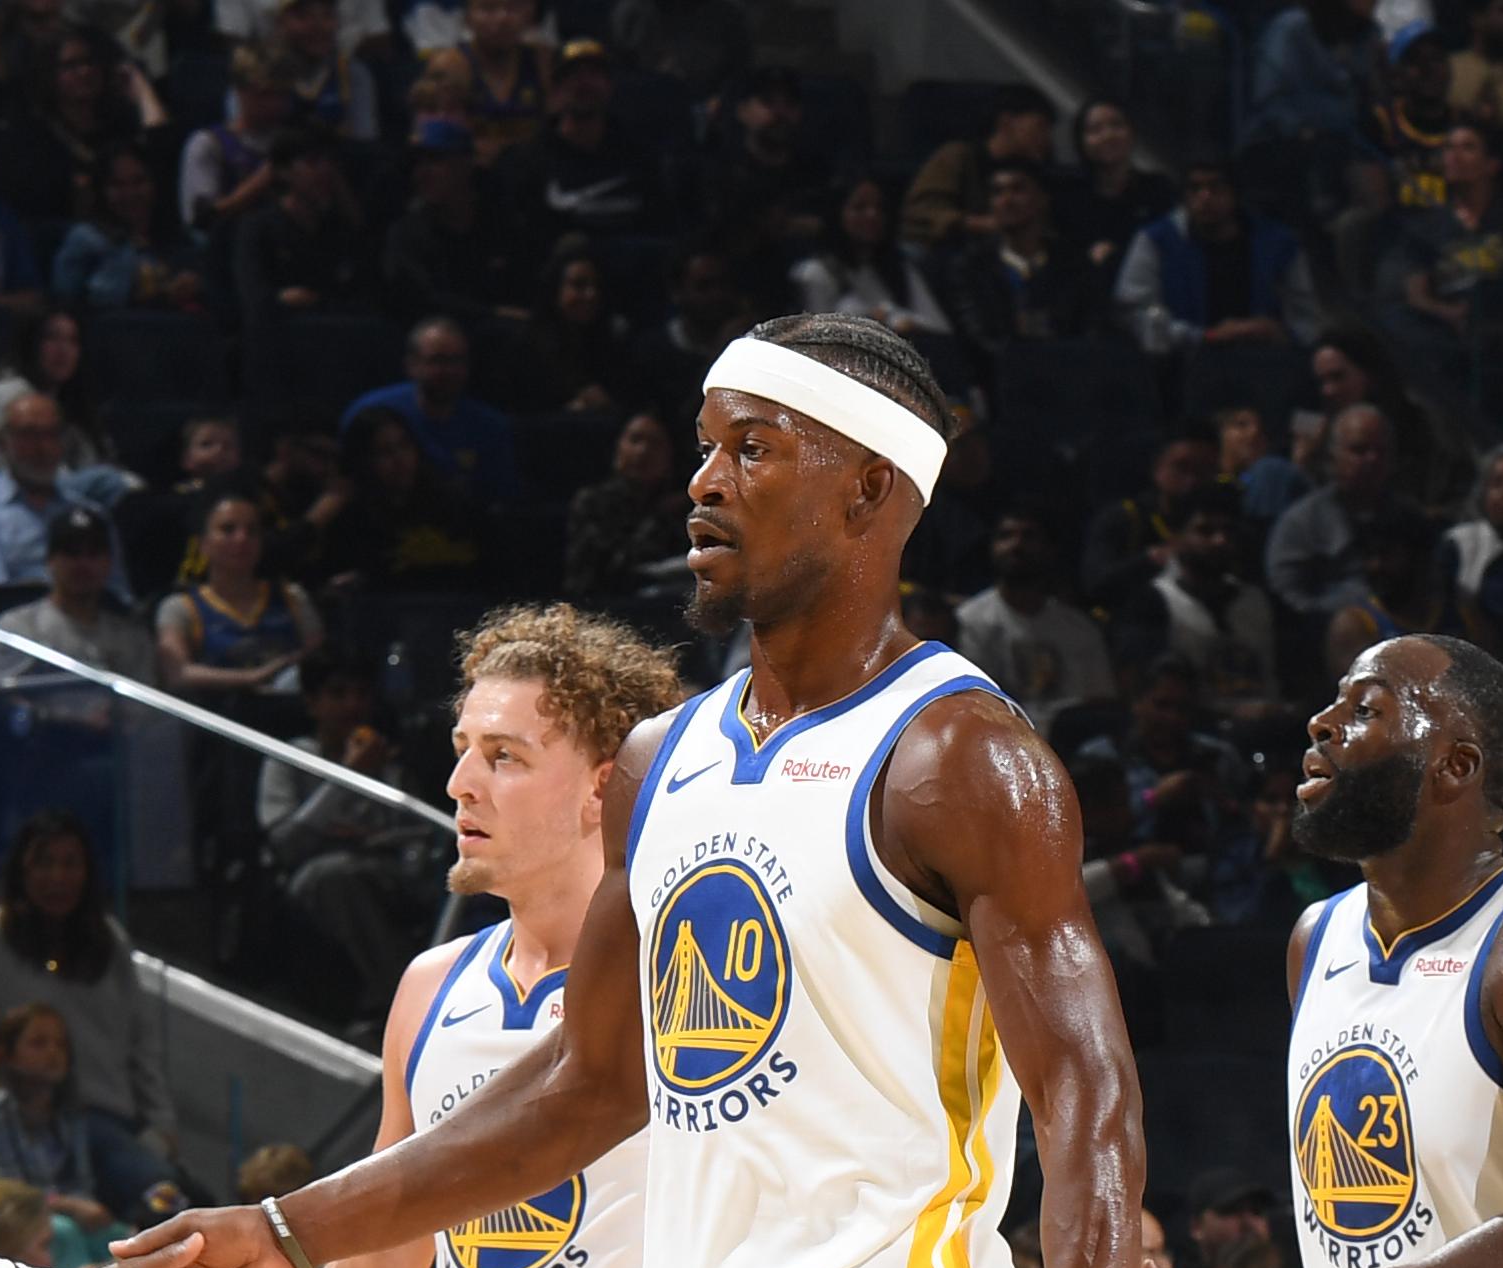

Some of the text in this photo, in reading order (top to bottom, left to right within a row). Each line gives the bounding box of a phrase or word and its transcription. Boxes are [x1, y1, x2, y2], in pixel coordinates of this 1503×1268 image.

[781, 758, 851, 782] Rakuten
[650, 832, 794, 908] GOLDEN STATE
[723, 918, 763, 982] 10
[1299, 1023, 1419, 1086] GOLDEN STATE
[653, 1051, 798, 1133] ARRIORS
[1357, 1095, 1398, 1149] 23
